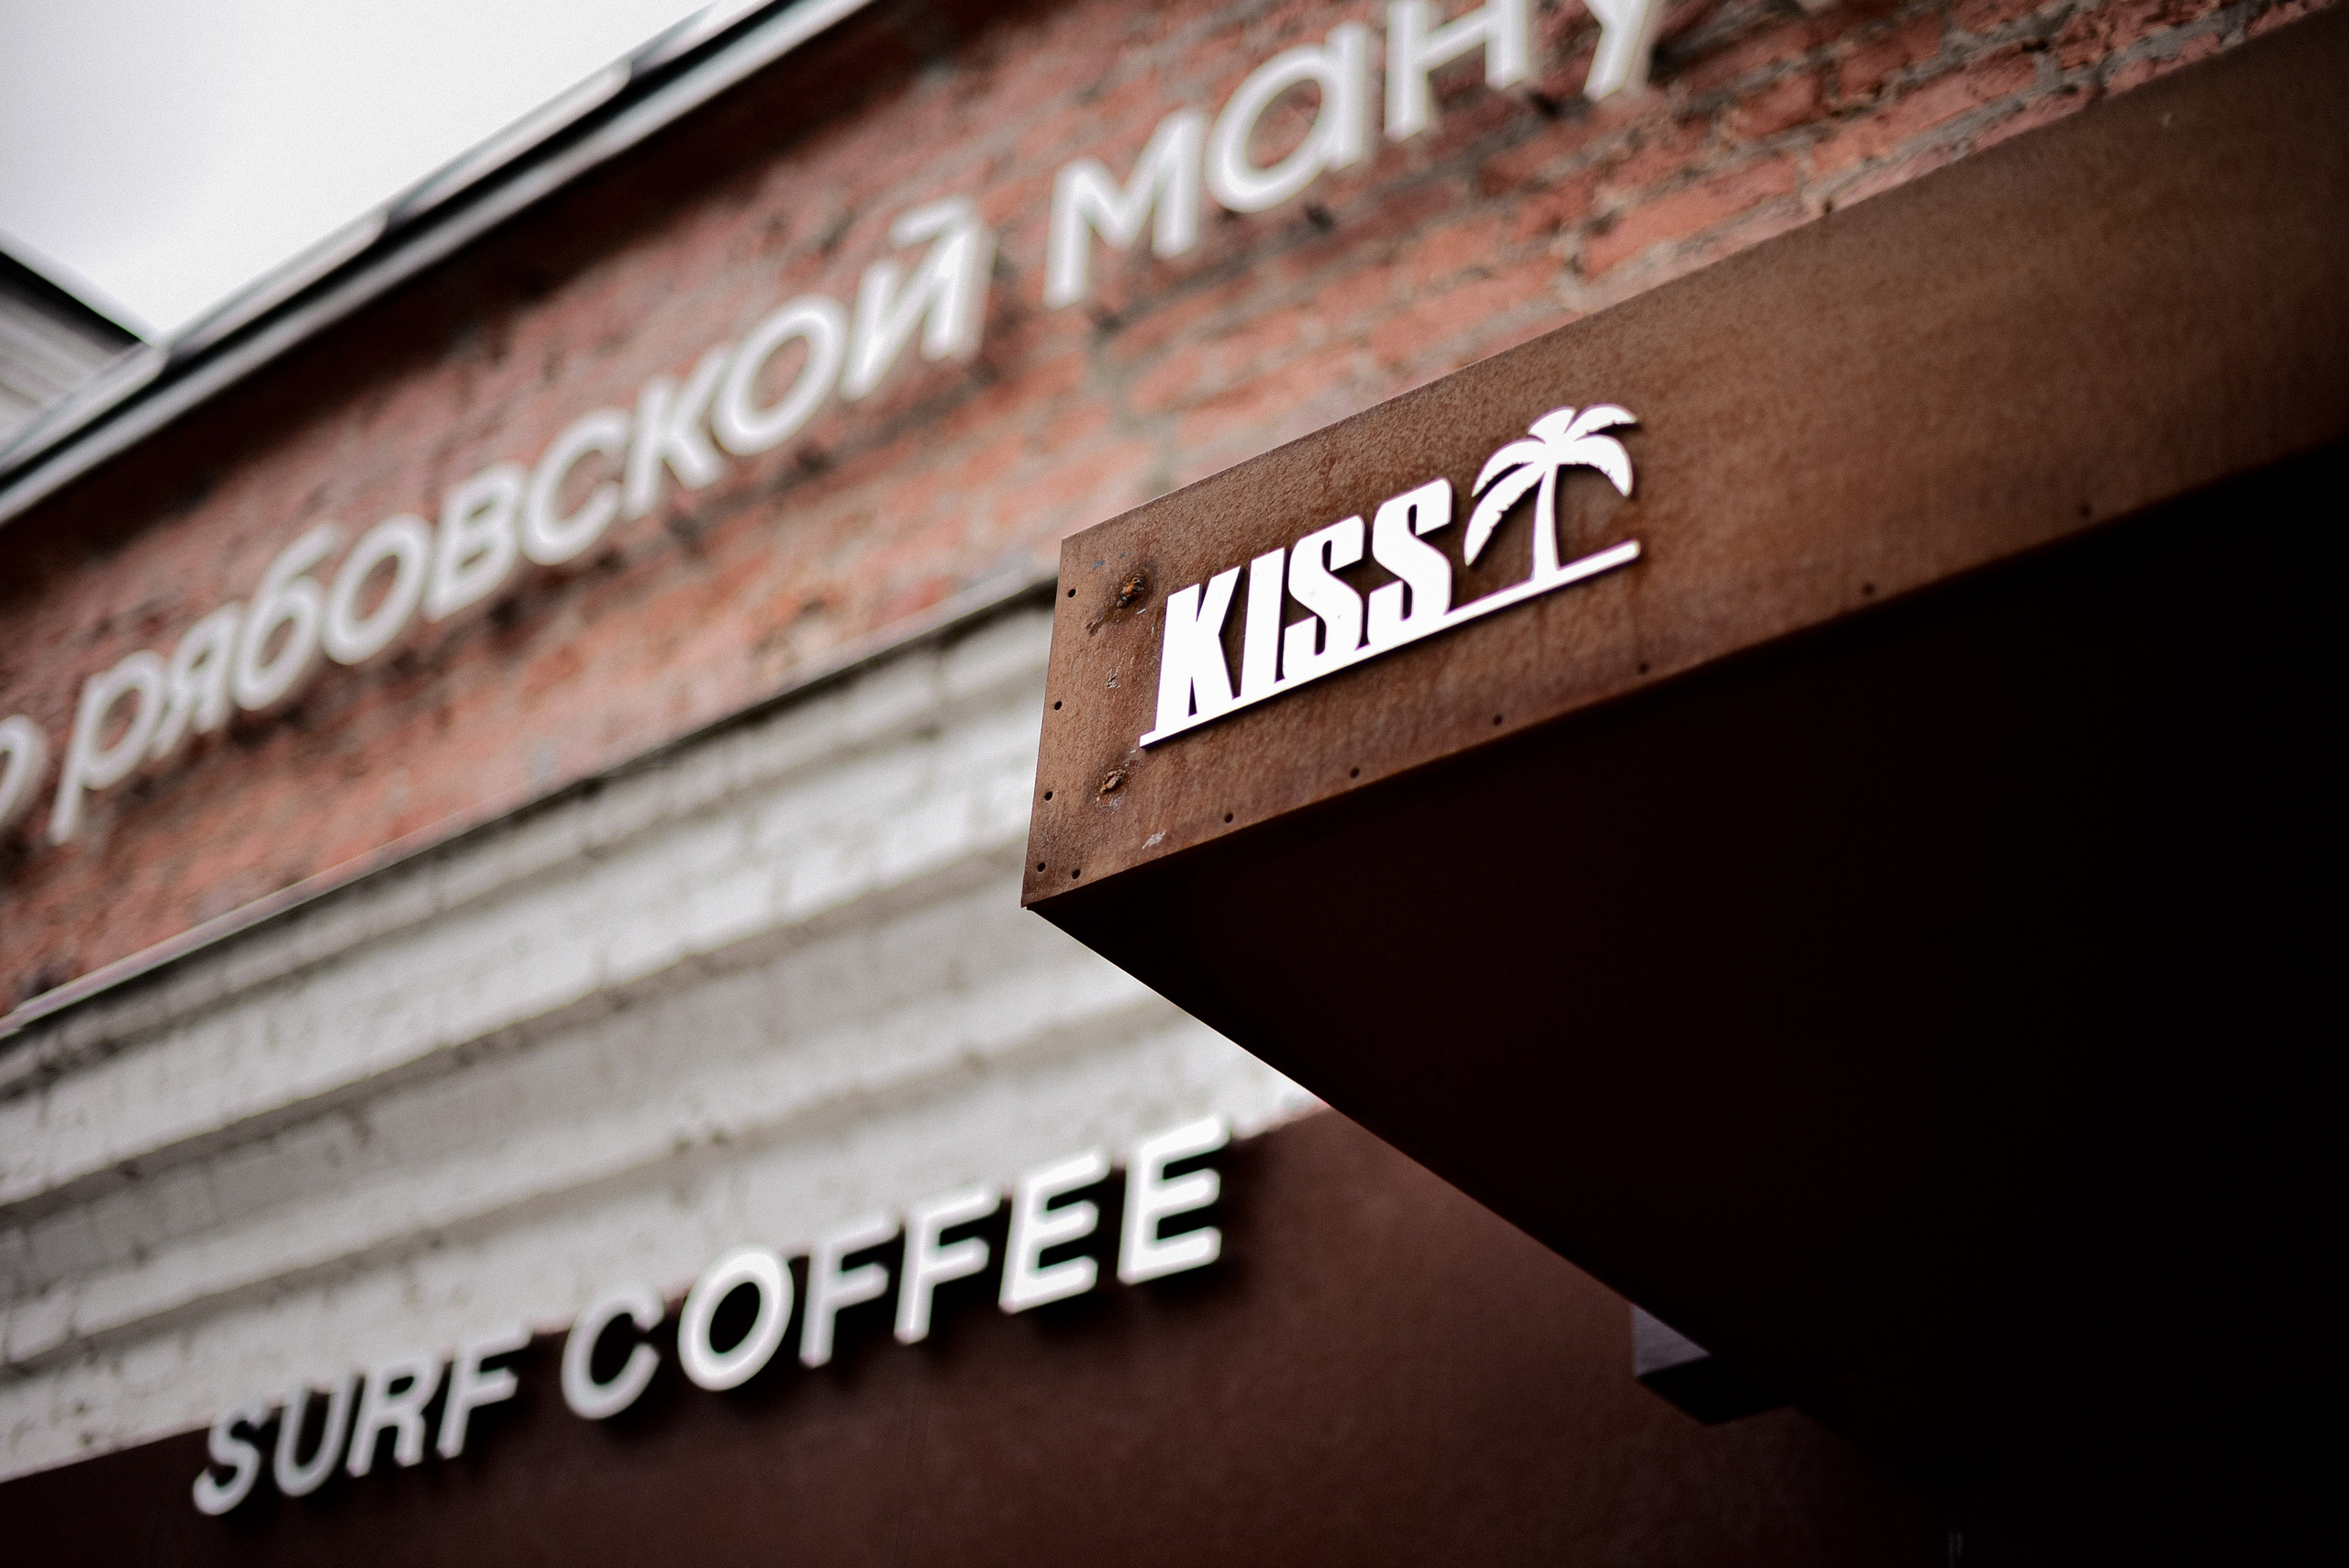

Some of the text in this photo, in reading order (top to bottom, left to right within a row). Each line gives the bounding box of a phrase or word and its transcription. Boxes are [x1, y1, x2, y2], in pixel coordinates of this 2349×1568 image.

[1152, 476, 1453, 734] KISS
[191, 1114, 1231, 1517] SURF COFFEE
